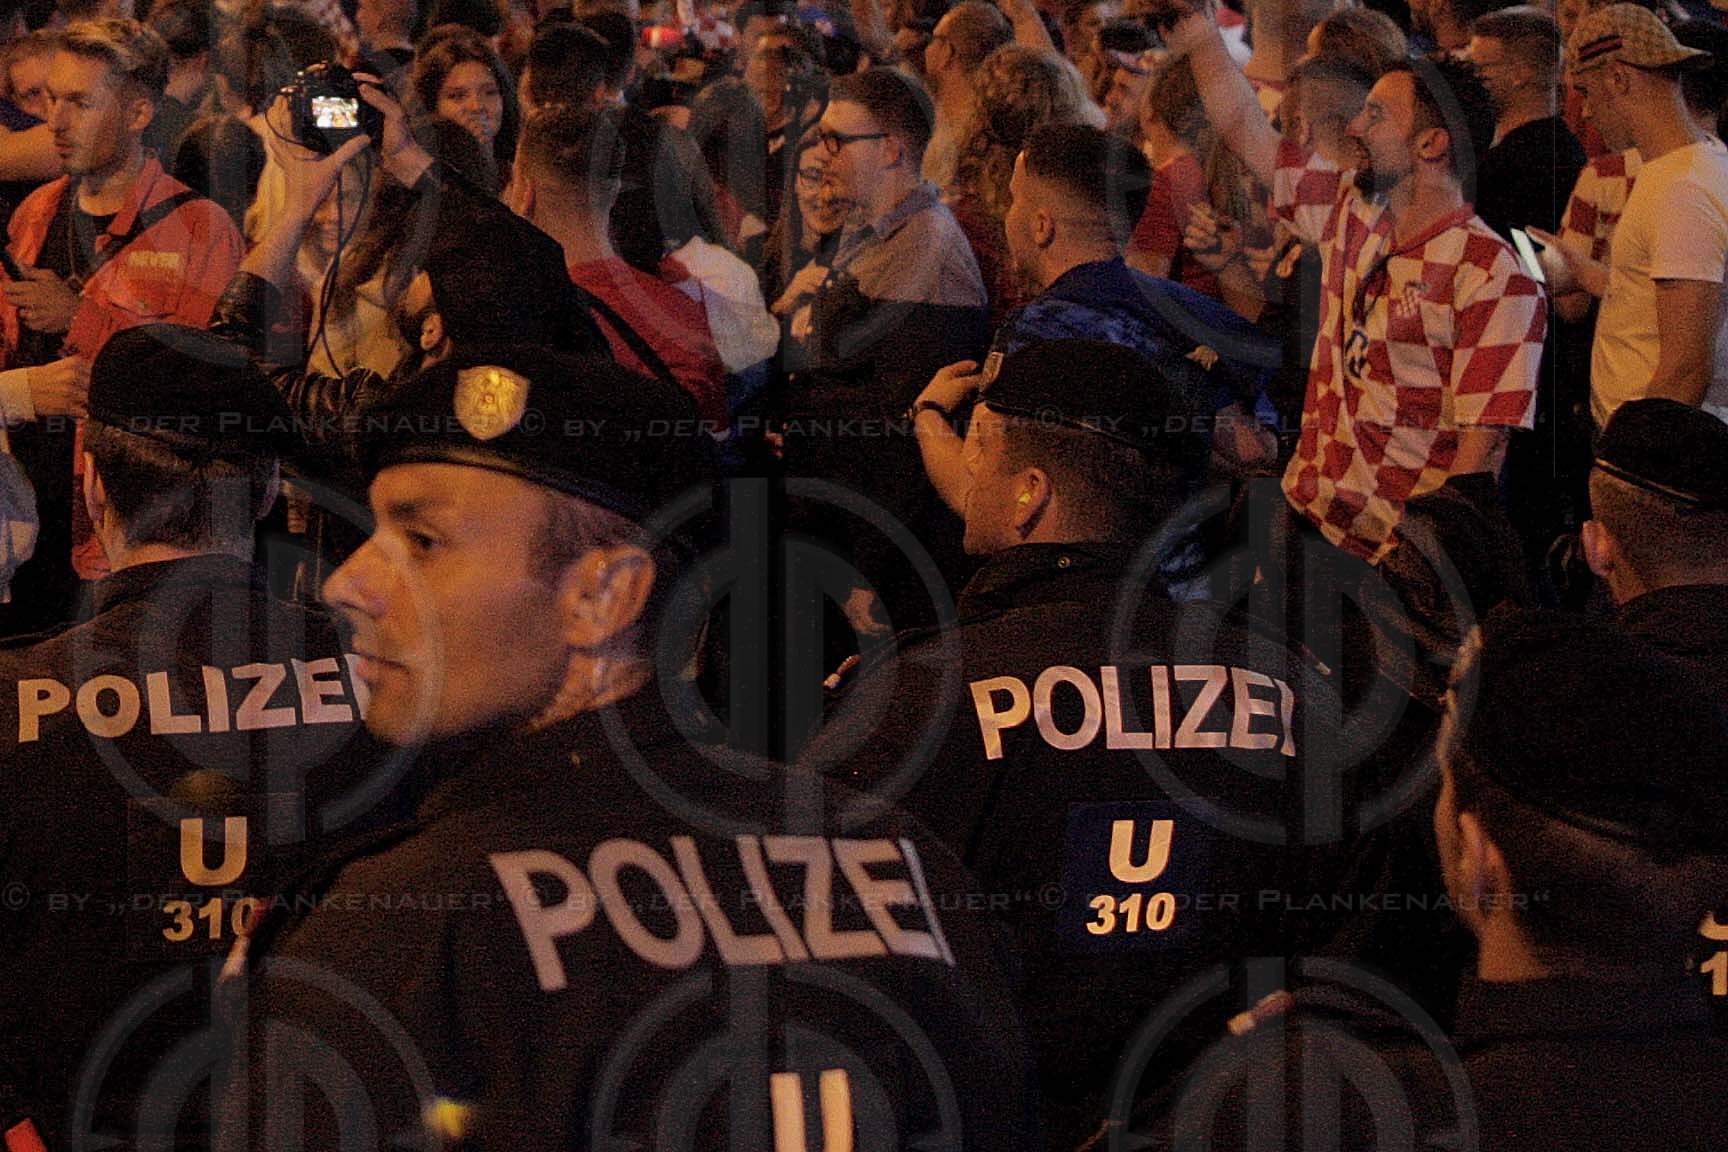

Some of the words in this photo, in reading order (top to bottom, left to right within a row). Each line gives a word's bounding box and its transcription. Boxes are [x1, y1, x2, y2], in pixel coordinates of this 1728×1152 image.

[969, 664, 1297, 760] POLIZEI
[180, 815, 249, 886] U
[1108, 819, 1174, 884] U
[162, 896, 262, 943] 310
[1085, 891, 1176, 936] 310
